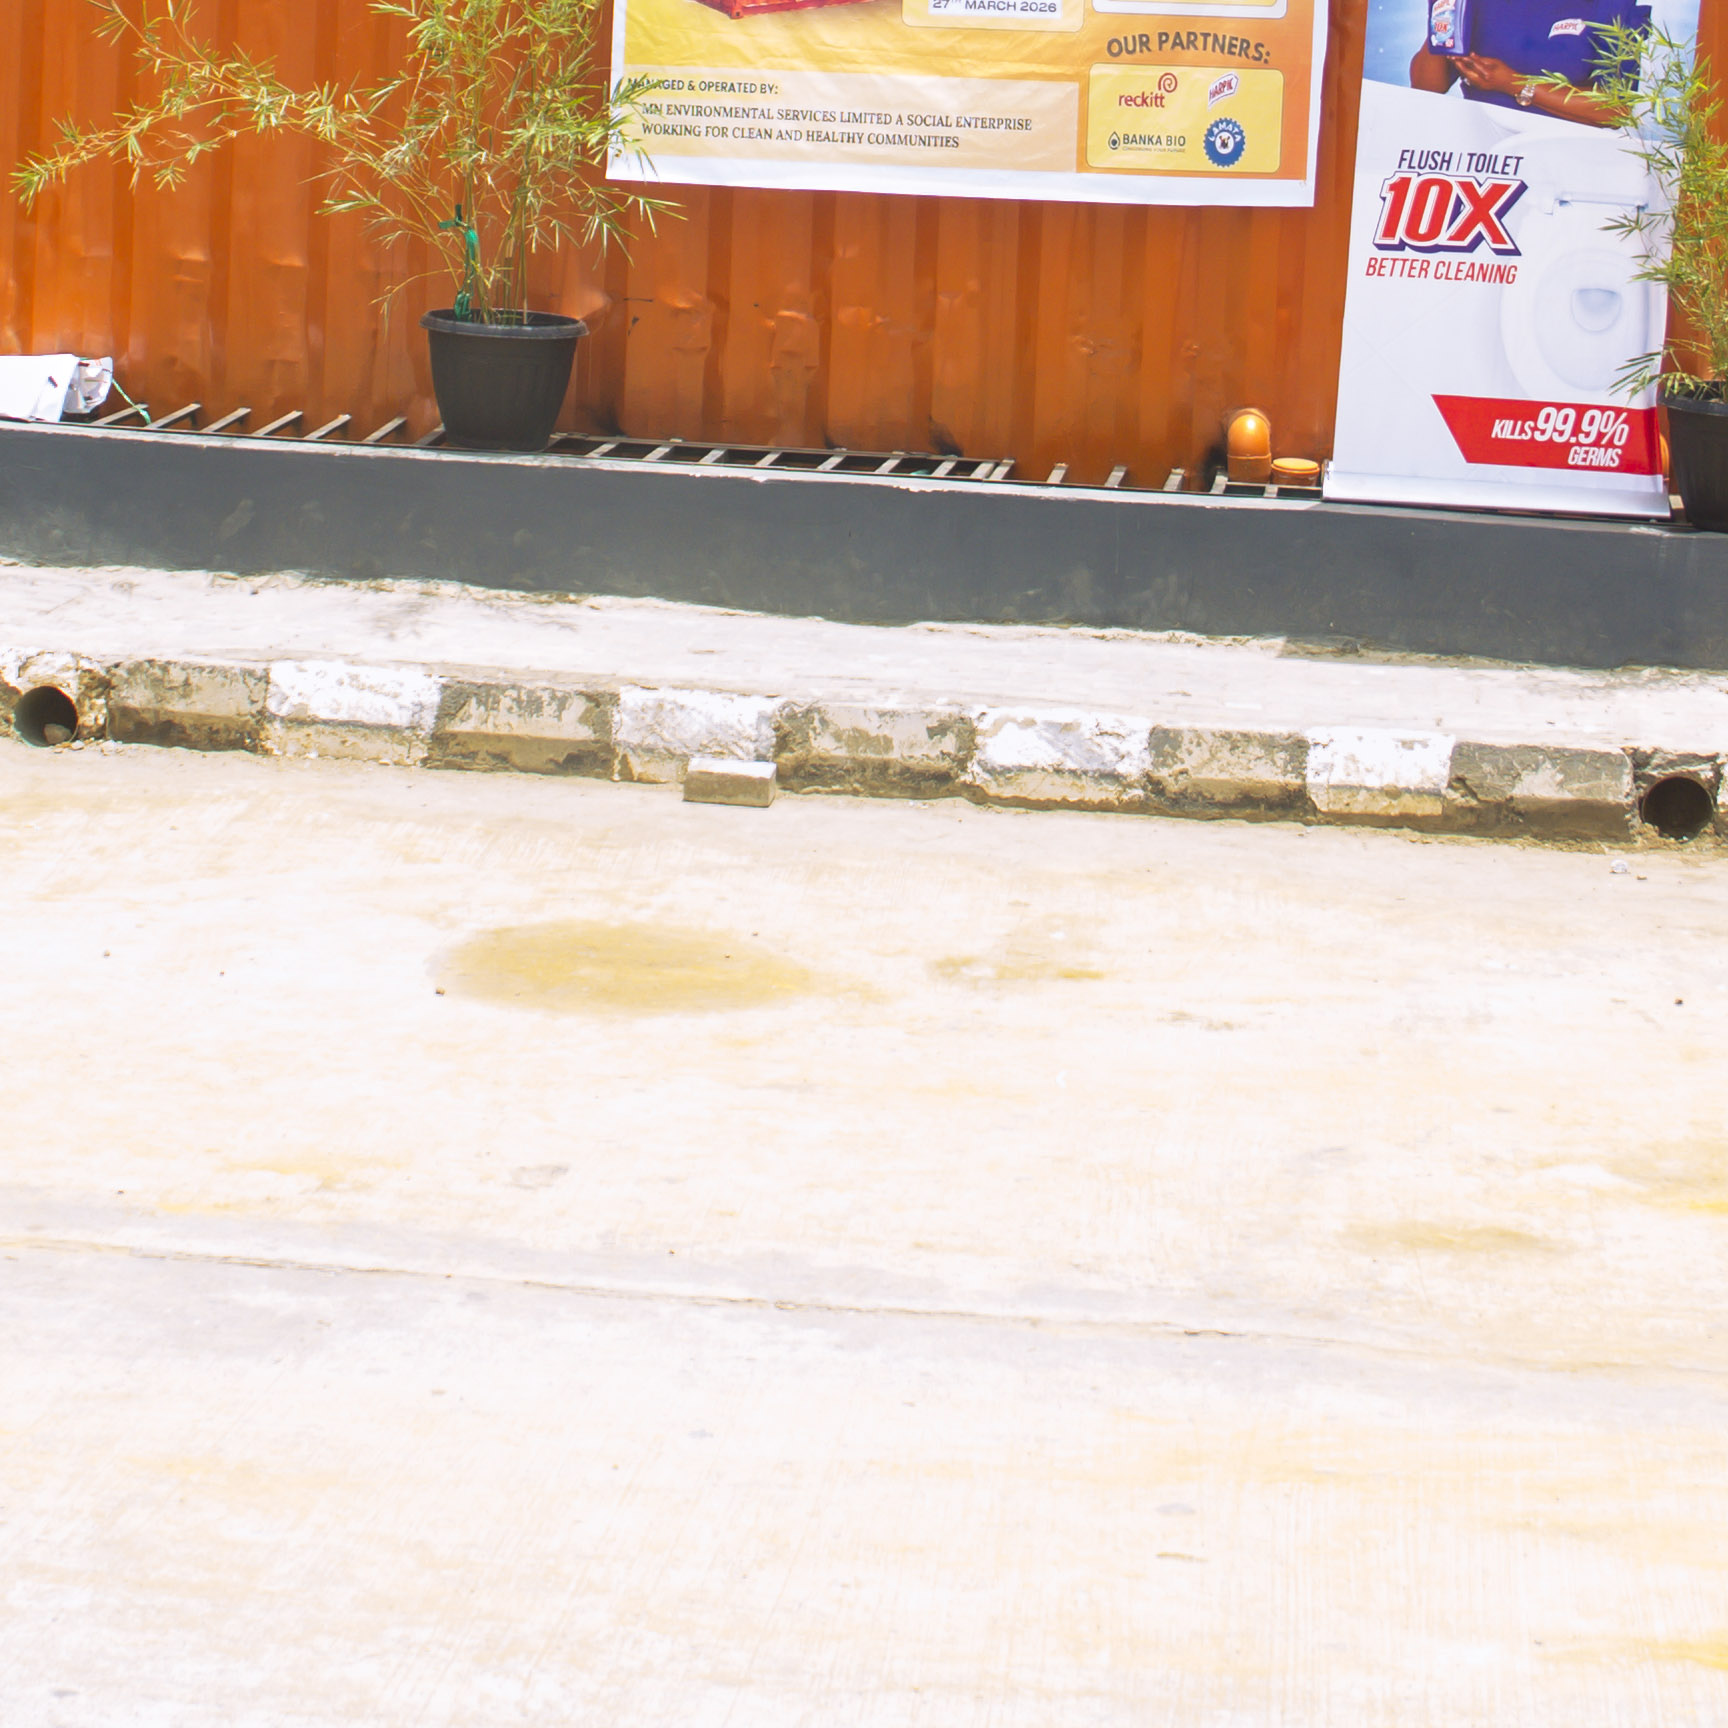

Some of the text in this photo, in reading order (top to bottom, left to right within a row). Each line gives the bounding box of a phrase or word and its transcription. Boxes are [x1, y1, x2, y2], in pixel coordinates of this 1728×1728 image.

[964, 0, 1016, 12] MARCH
[1020, 2, 1057, 12] 2026
[1107, 32, 1270, 64] OUR PARTNERS:
[688, 80, 695, 91] &
[698, 80, 756, 94] OPERATED
[760, 84, 778, 94] BY:
[1118, 92, 1165, 108] reckitt
[642, 103, 1032, 130] MN ENVIRONMENTAL SERVICES LIMITED A SOCIAL ENTERPRISE
[642, 123, 960, 148] WORKING FOR CLEAN AND HEALTHY COMMUNITIES
[1123, 134, 1186, 146] BANKA BIO
[1208, 122, 1242, 142] LAMATA
[1398, 150, 1524, 176] FLUSH TOILET
[1376, 172, 1520, 251] 10X
[1366, 257, 1518, 284] BETTER CLEANING
[1491, 406, 1630, 446] KILLS 99.9%
[1568, 446, 1622, 468] GERMS
